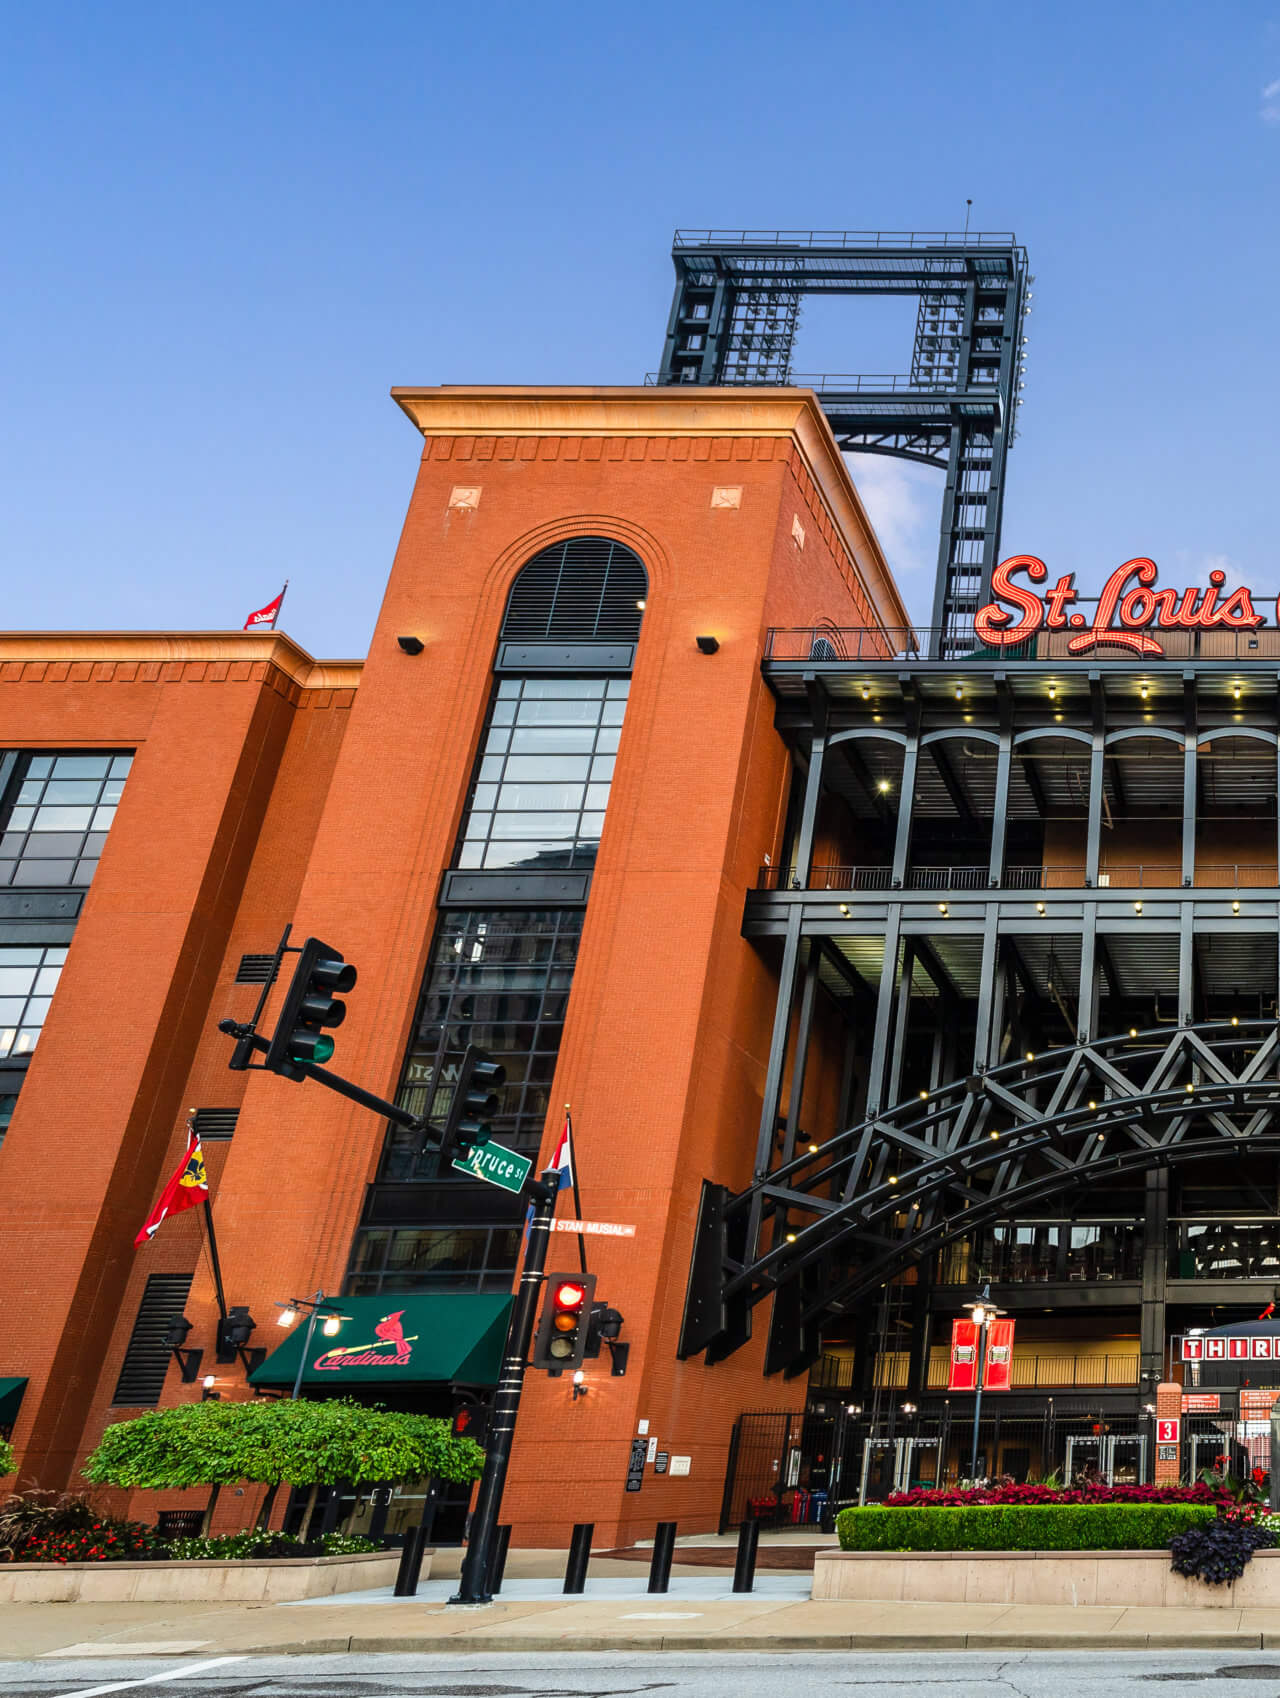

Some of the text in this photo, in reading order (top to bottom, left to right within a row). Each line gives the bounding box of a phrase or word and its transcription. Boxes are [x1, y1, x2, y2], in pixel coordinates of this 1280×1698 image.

[974, 555, 1085, 648] St.
[1067, 557, 1267, 657] Louis
[470, 1149, 514, 1178] pruce
[557, 1220, 584, 1233] STAN
[585, 1222, 624, 1236] MUSIAL
[313, 1347, 411, 1370] Cardinals
[1164, 1422, 1172, 1440] 3
